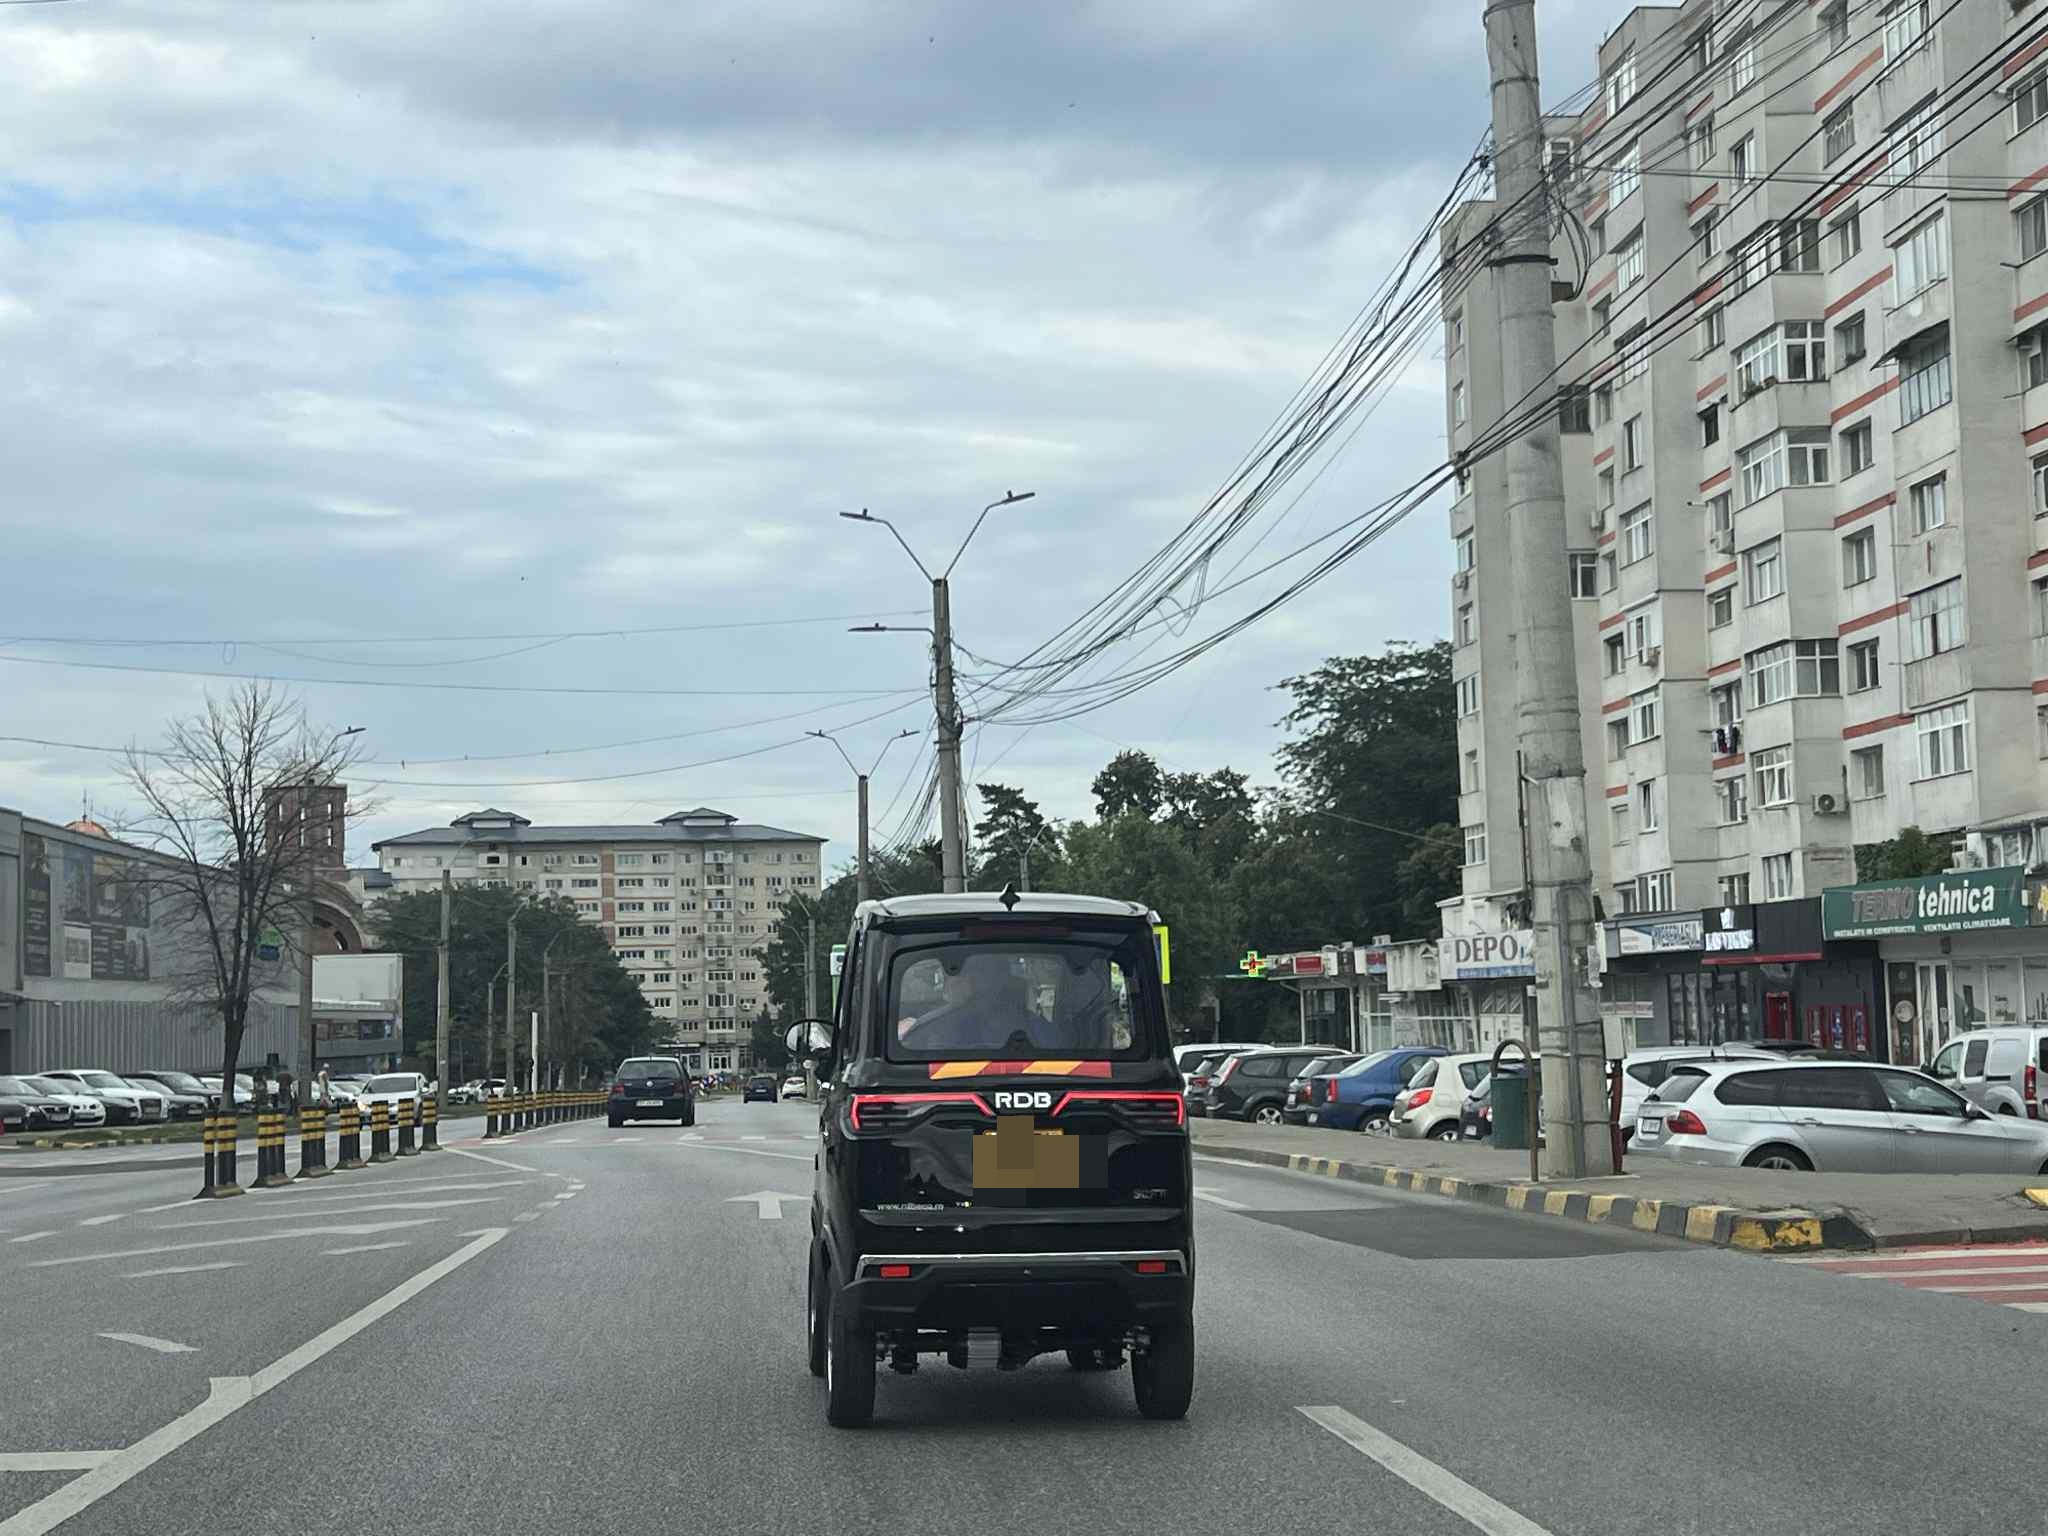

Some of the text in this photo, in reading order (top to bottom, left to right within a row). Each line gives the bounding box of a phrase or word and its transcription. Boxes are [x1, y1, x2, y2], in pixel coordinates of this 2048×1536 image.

[1852, 880, 1994, 922] TERMO tehnica
[995, 1092, 1052, 1109] RDB
